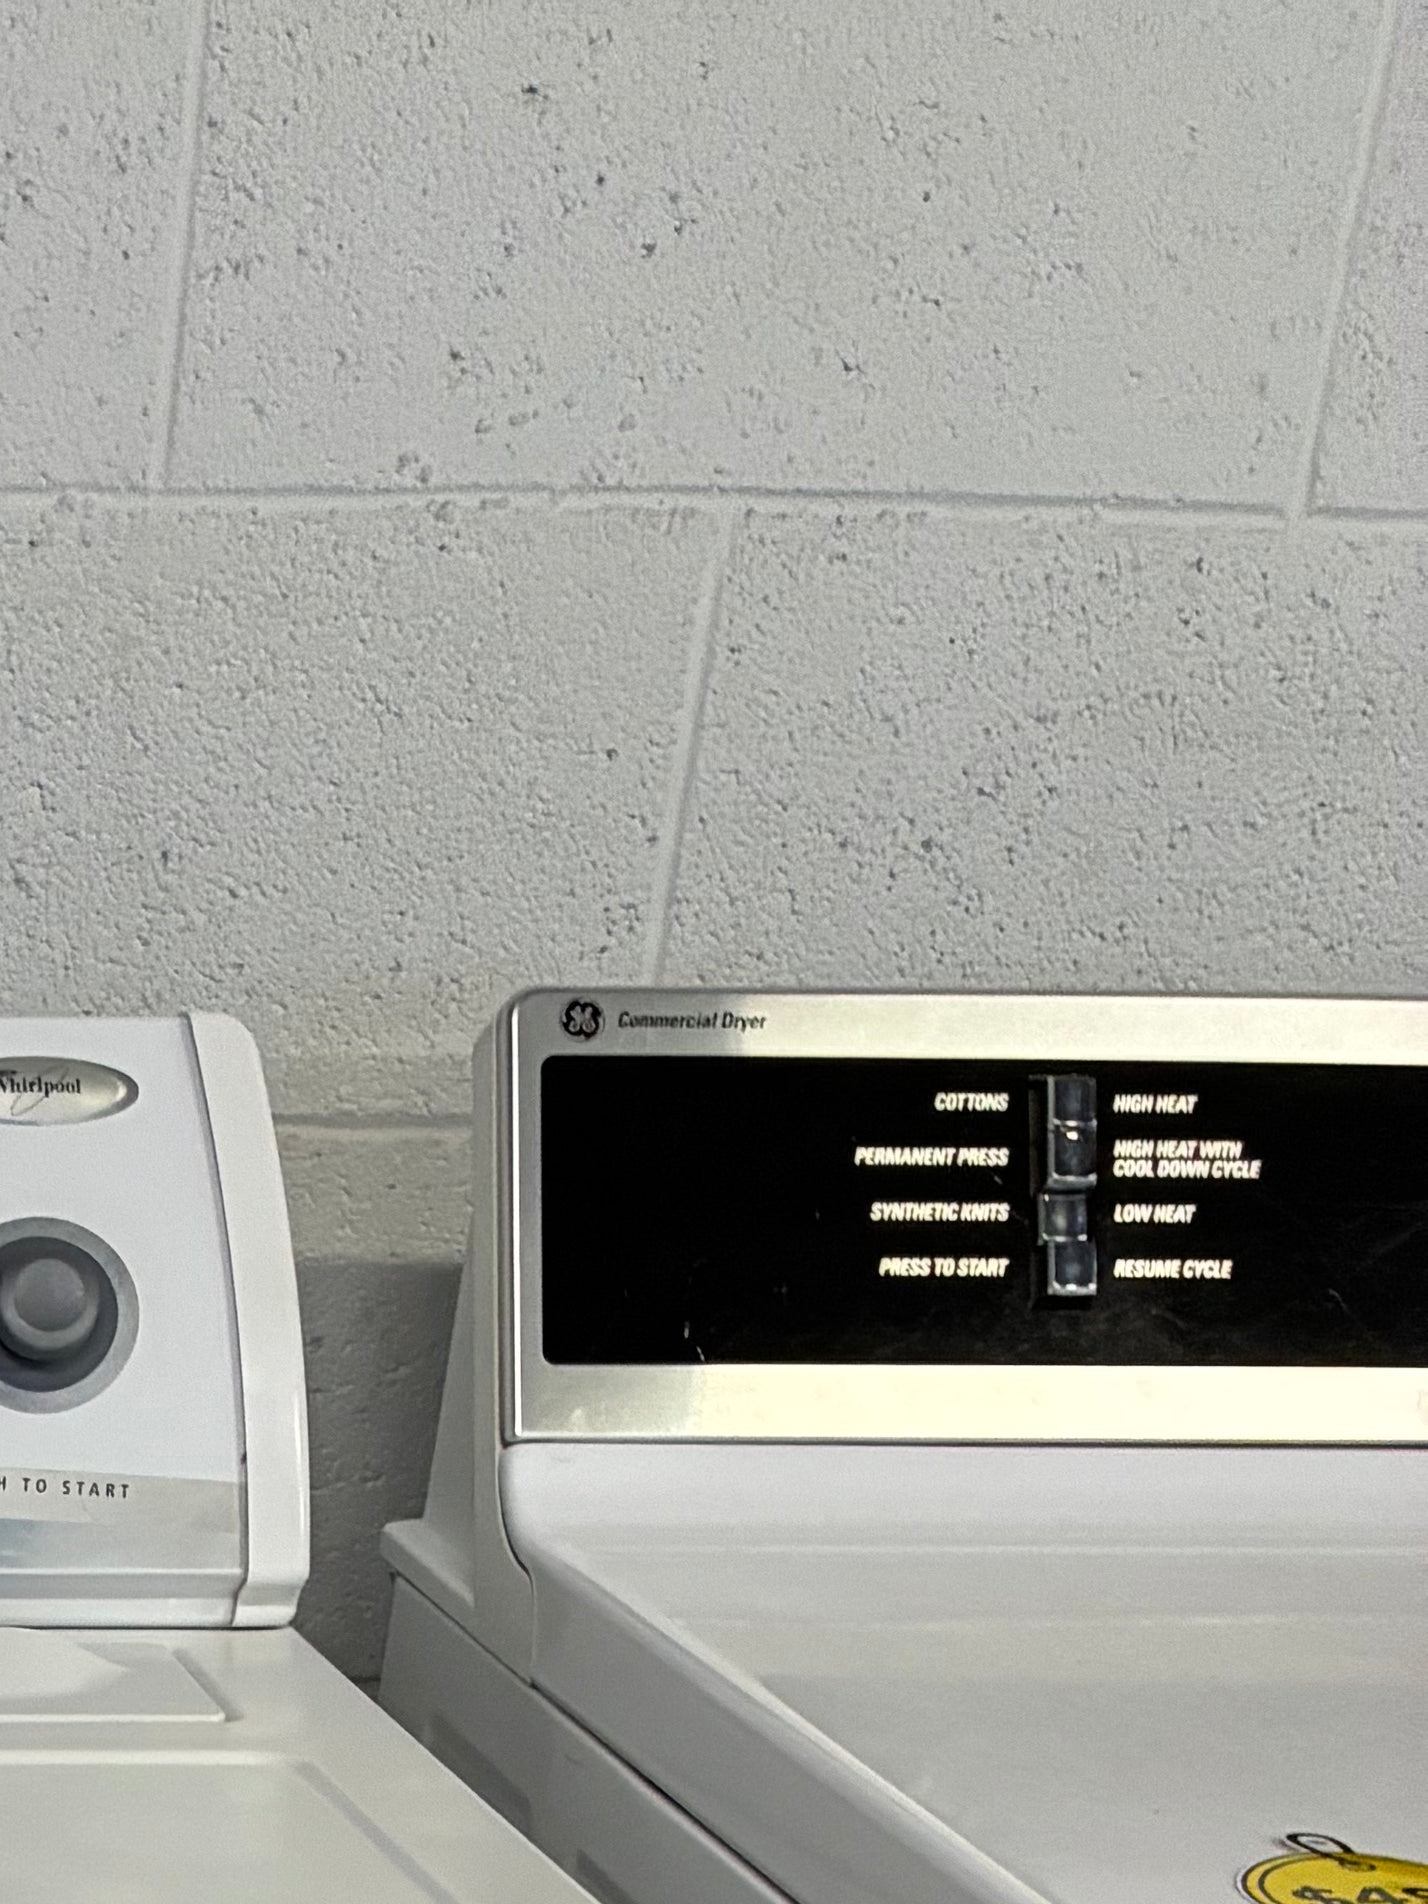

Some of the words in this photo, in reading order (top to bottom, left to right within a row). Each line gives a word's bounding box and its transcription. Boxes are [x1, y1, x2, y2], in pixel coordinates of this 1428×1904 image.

[618, 1011, 717, 1029] Commercial
[721, 1012, 766, 1032] Dryer
[934, 1092, 1010, 1112] COTTONS
[1113, 1094, 1154, 1113] HIGH
[1155, 1094, 1199, 1114] HEAT
[854, 1146, 956, 1167] PERMANENT
[956, 1147, 1010, 1167] PRESS
[1113, 1139, 1154, 1158] HIGH
[1156, 1140, 1199, 1158] HEAT
[1199, 1140, 1243, 1159] WITH
[1113, 1160, 1154, 1178] COOL
[1156, 1160, 1210, 1179] DOWN
[1211, 1160, 1262, 1180] CYCLE
[870, 1201, 959, 1222] SYNTHETIC
[960, 1202, 1011, 1222] KNITS
[1114, 1203, 1153, 1223] LOW
[1153, 1204, 1197, 1224] HEAT
[878, 1257, 932, 1277] PRESS
[934, 1257, 956, 1277] TO
[957, 1257, 1010, 1278] START
[1113, 1258, 1182, 1279] RESUME
[1182, 1258, 1233, 1280] CYCLE
[22, 1476, 48, 1494] TO
[62, 1479, 130, 1500] START
